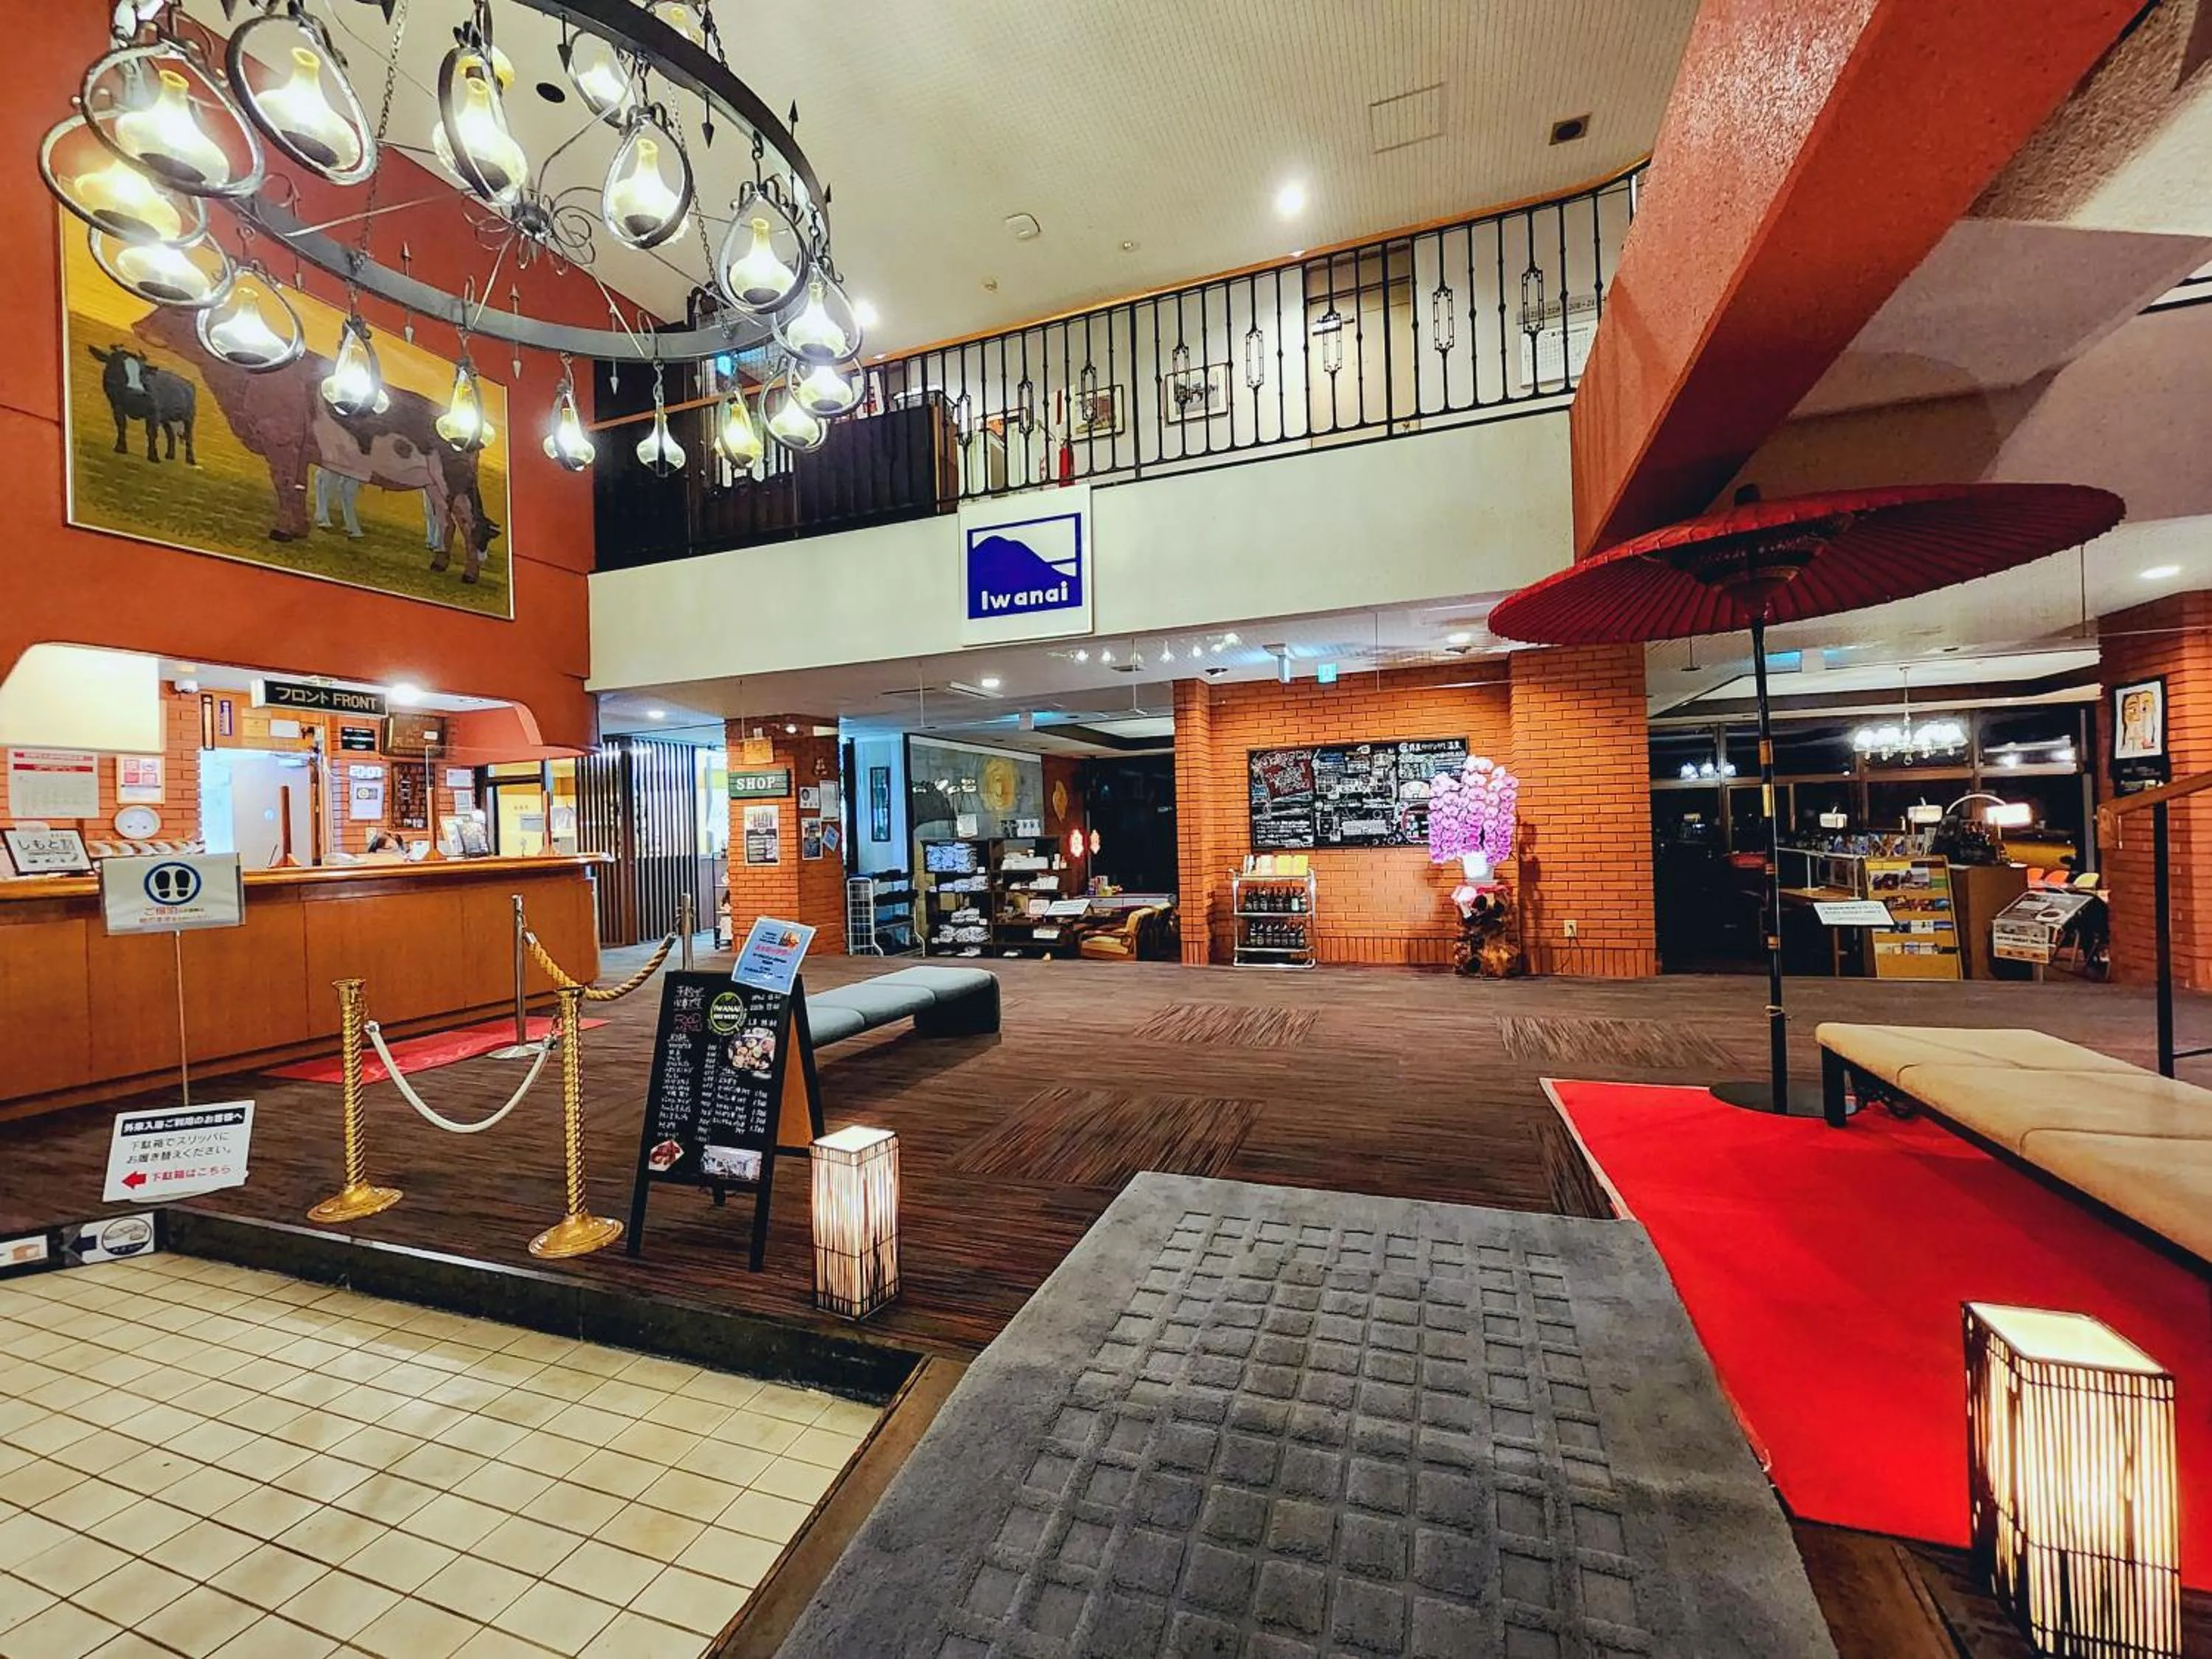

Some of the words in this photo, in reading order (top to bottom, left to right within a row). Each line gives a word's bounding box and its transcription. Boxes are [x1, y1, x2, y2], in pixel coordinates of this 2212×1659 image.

[981, 580, 1068, 611] Iwanai
[274, 686, 330, 704] フロント
[333, 692, 378, 710] FRONT
[737, 776, 776, 790] SHOP
